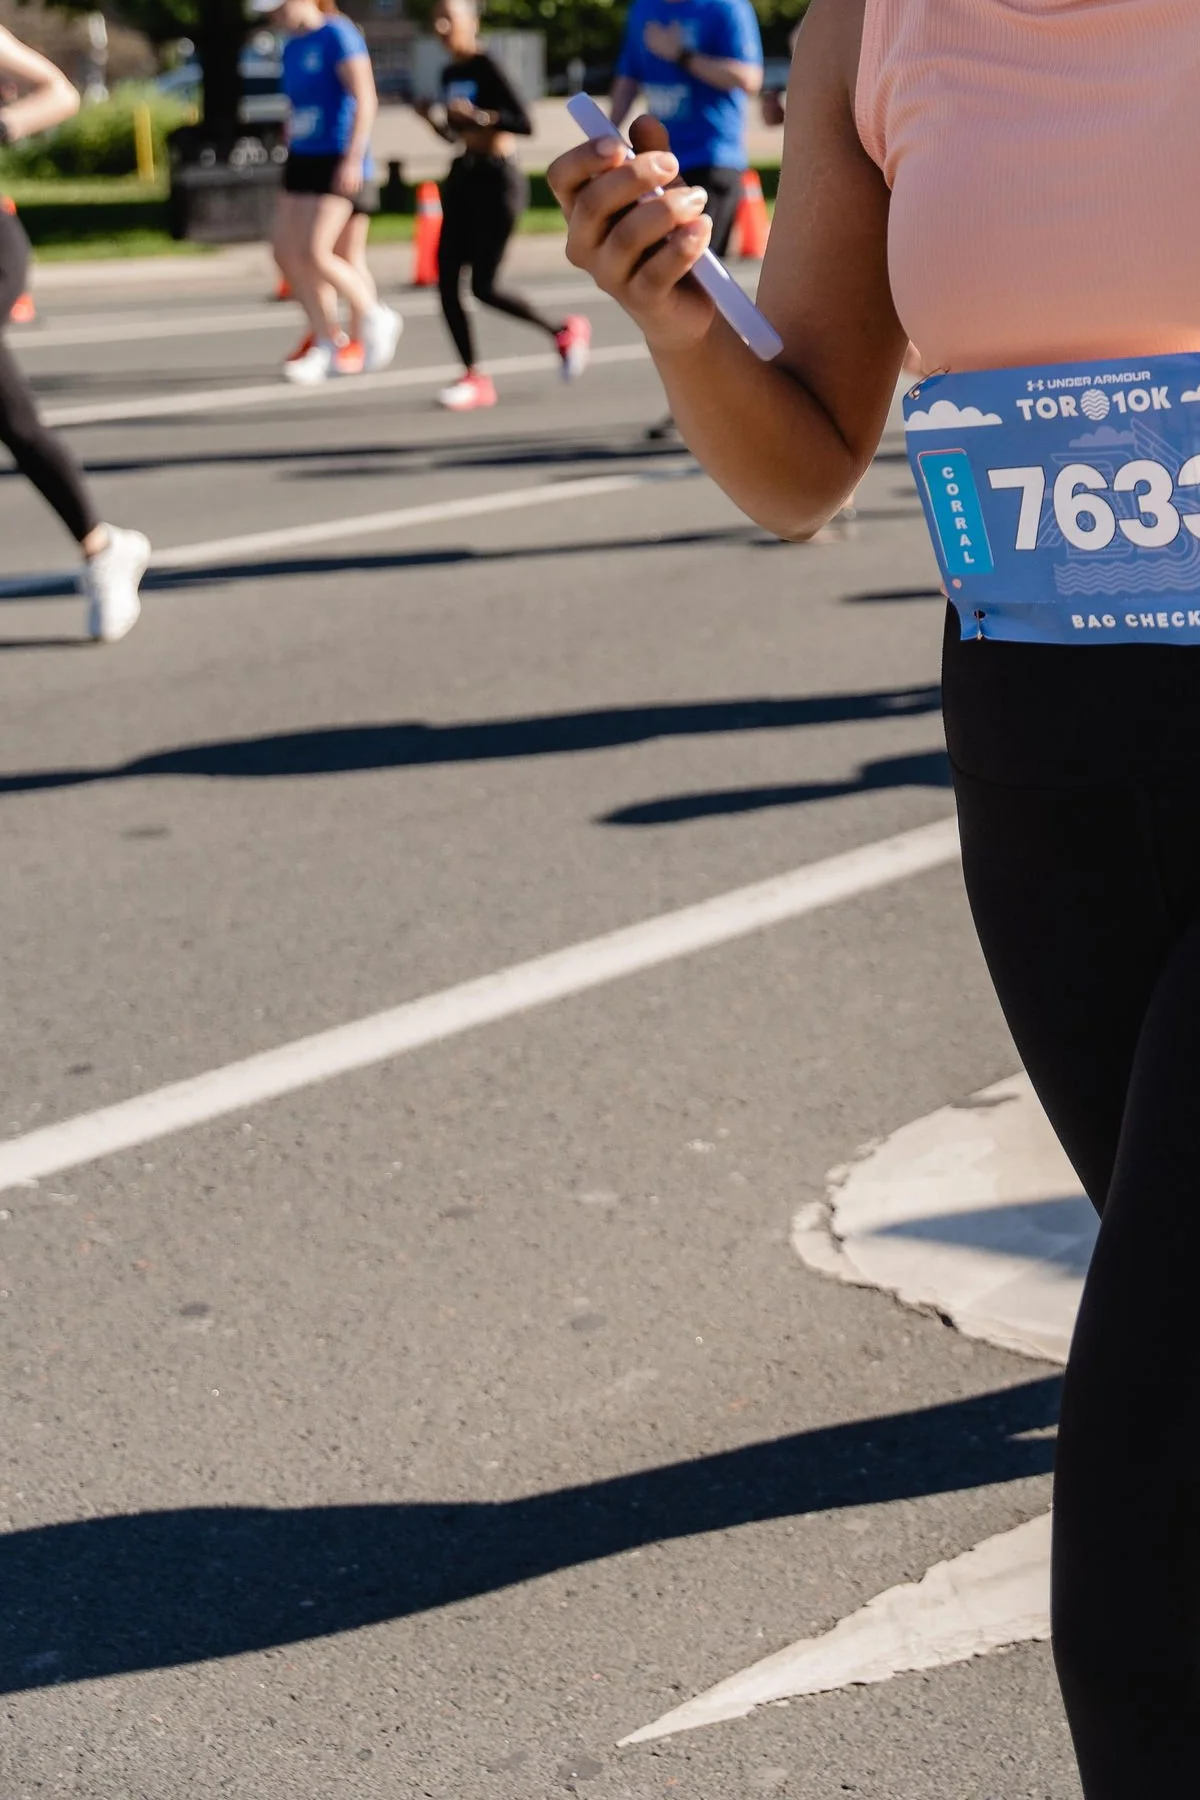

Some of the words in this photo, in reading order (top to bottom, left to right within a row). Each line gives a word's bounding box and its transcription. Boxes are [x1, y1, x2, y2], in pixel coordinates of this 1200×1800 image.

[1047, 376, 1092, 389] UNDER
[1093, 370, 1151, 386] ARMOUR
[941, 466, 975, 564] CORRAL
[1071, 614, 1117, 629] BAG
